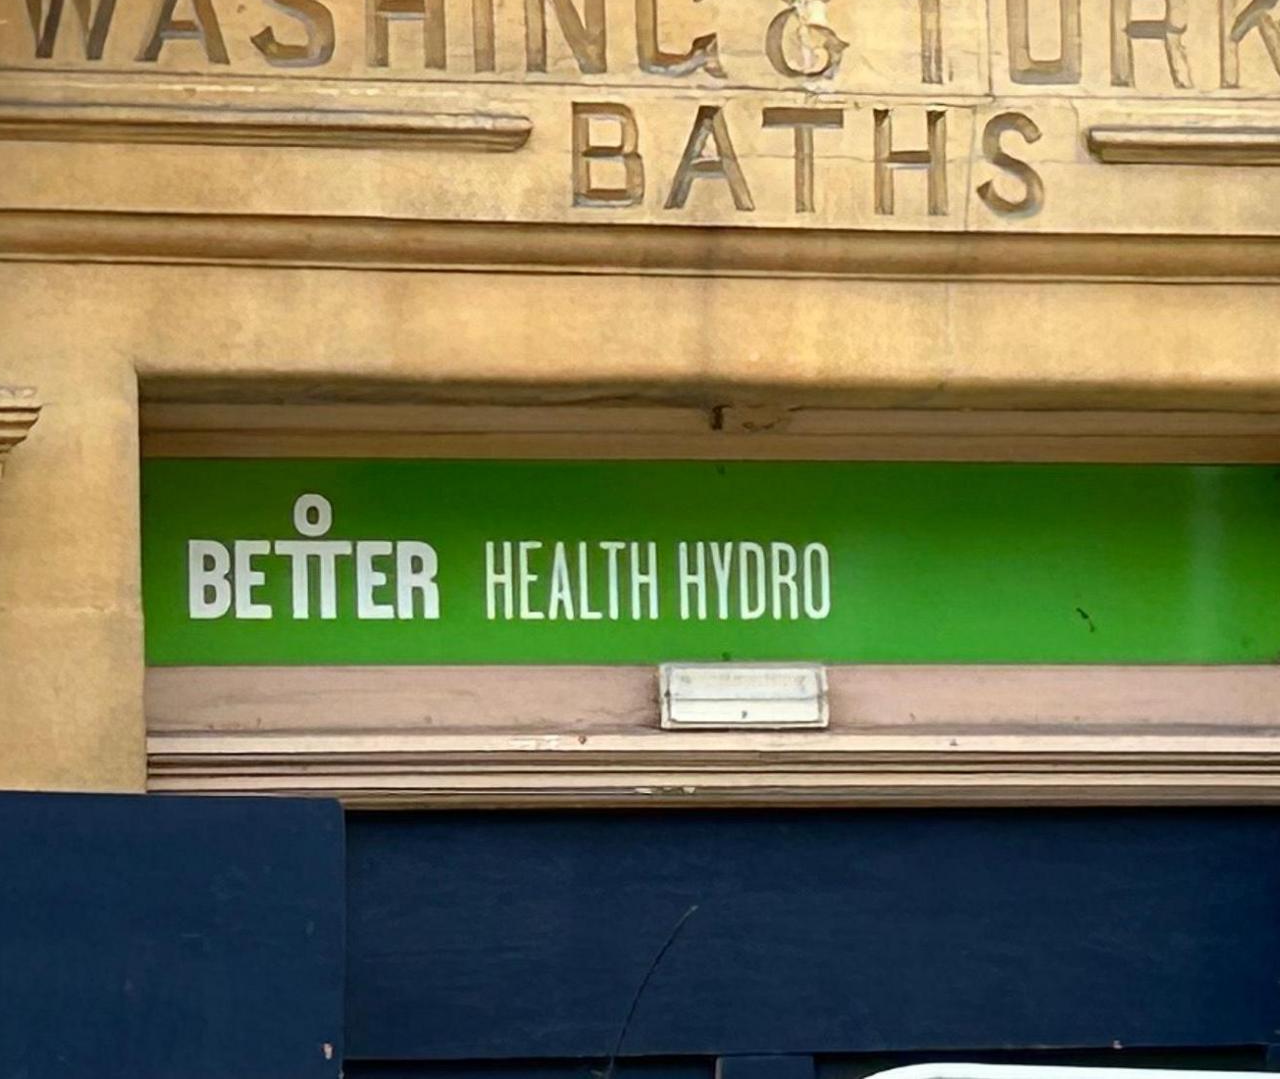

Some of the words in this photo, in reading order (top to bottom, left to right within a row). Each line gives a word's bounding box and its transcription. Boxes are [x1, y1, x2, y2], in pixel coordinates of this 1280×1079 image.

[571, 101, 1045, 218] BATHS
[188, 493, 440, 621] BETTER
[485, 540, 659, 621] HEALTH
[678, 540, 833, 621] HYDRO
